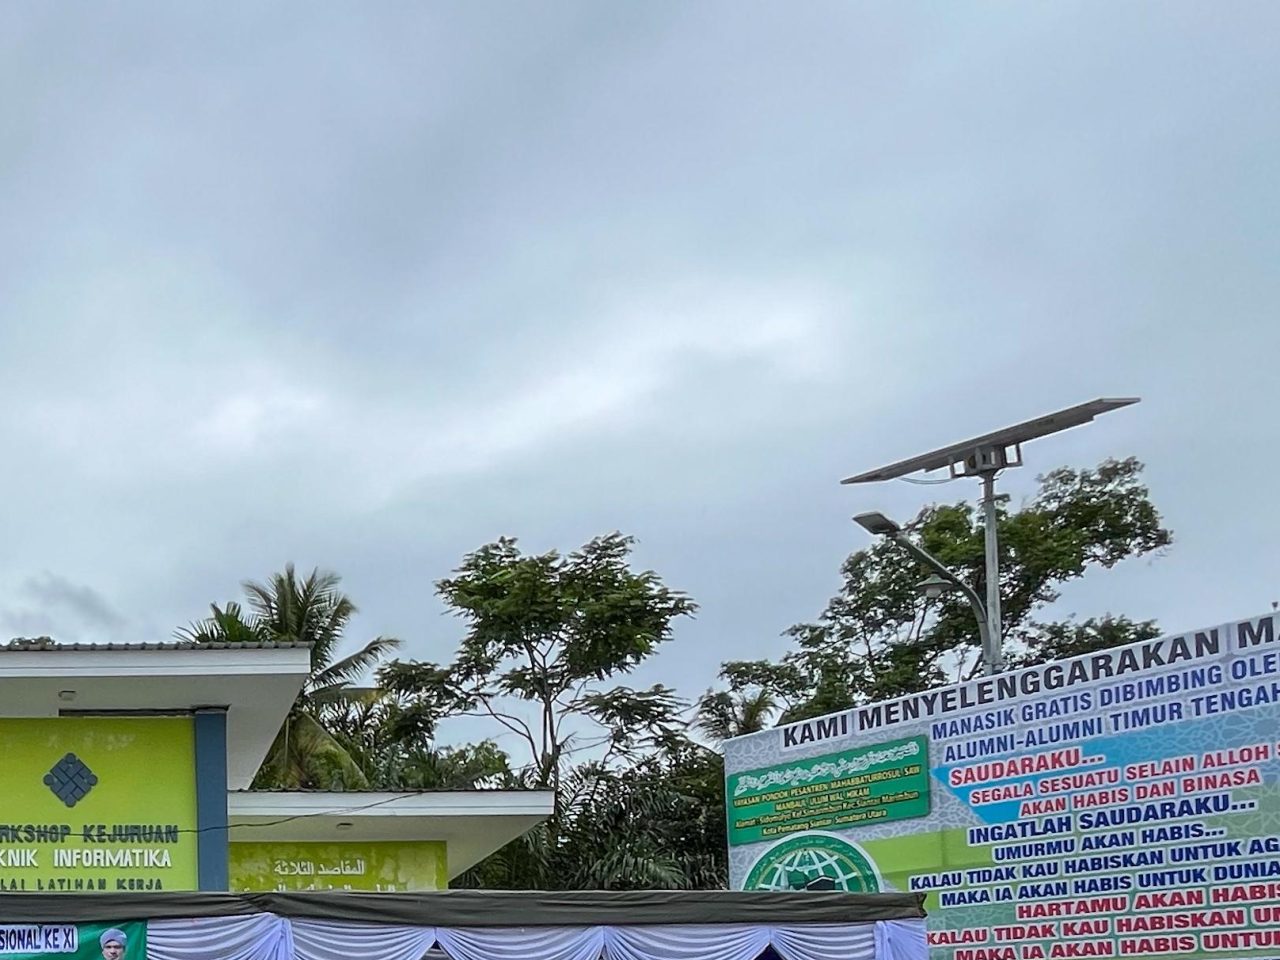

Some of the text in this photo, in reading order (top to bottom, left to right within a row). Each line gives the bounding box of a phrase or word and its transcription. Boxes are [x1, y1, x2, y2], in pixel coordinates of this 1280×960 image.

[784, 616, 1280, 748] KAMI MENYELENGGARAKAN M
[932, 653, 1280, 741] MANASIK GRATIS DIBIMBING OLE
[945, 716, 1103, 762] ALUMNI-ALUMNI
[1110, 702, 1183, 732] TIMUR
[971, 784, 1033, 805] SEGALA
[1039, 770, 1119, 793] SESUATU
[1126, 758, 1195, 779] SELAIN
[1203, 745, 1269, 769] ALLOH
[1021, 769, 1260, 817] AKAN HABIS DAN BINASA
[83, 824, 179, 843] KEJURUAN
[969, 816, 1072, 845] INGATLAH
[995, 839, 1075, 861] UMURMU
[1081, 832, 1134, 851] AKAN
[53, 848, 172, 868] INFORMATIKA
[910, 872, 962, 890] KALAU
[967, 867, 1016, 884] TIDAK
[1022, 862, 1058, 879] KAU
[1064, 850, 1163, 874] HABISKAN
[1171, 841, 1242, 863] UNTUK
[941, 860, 1280, 906] MAKA IA AKAN HABIS UNTUK DUNIA
[1018, 896, 1127, 918] HARTAMU
[1135, 890, 1203, 910] AKAN
[44, 927, 61, 949] KE
[63, 926, 75, 948] XI
[926, 929, 987, 945] KALAU
[993, 924, 1056, 941] TIDAK
[1063, 919, 1108, 936] KAU
[1117, 910, 1244, 933] HABISKAN
[1023, 946, 1044, 959] IA
[1051, 941, 1112, 957] AKAN
[1121, 936, 1195, 954] HABIS
